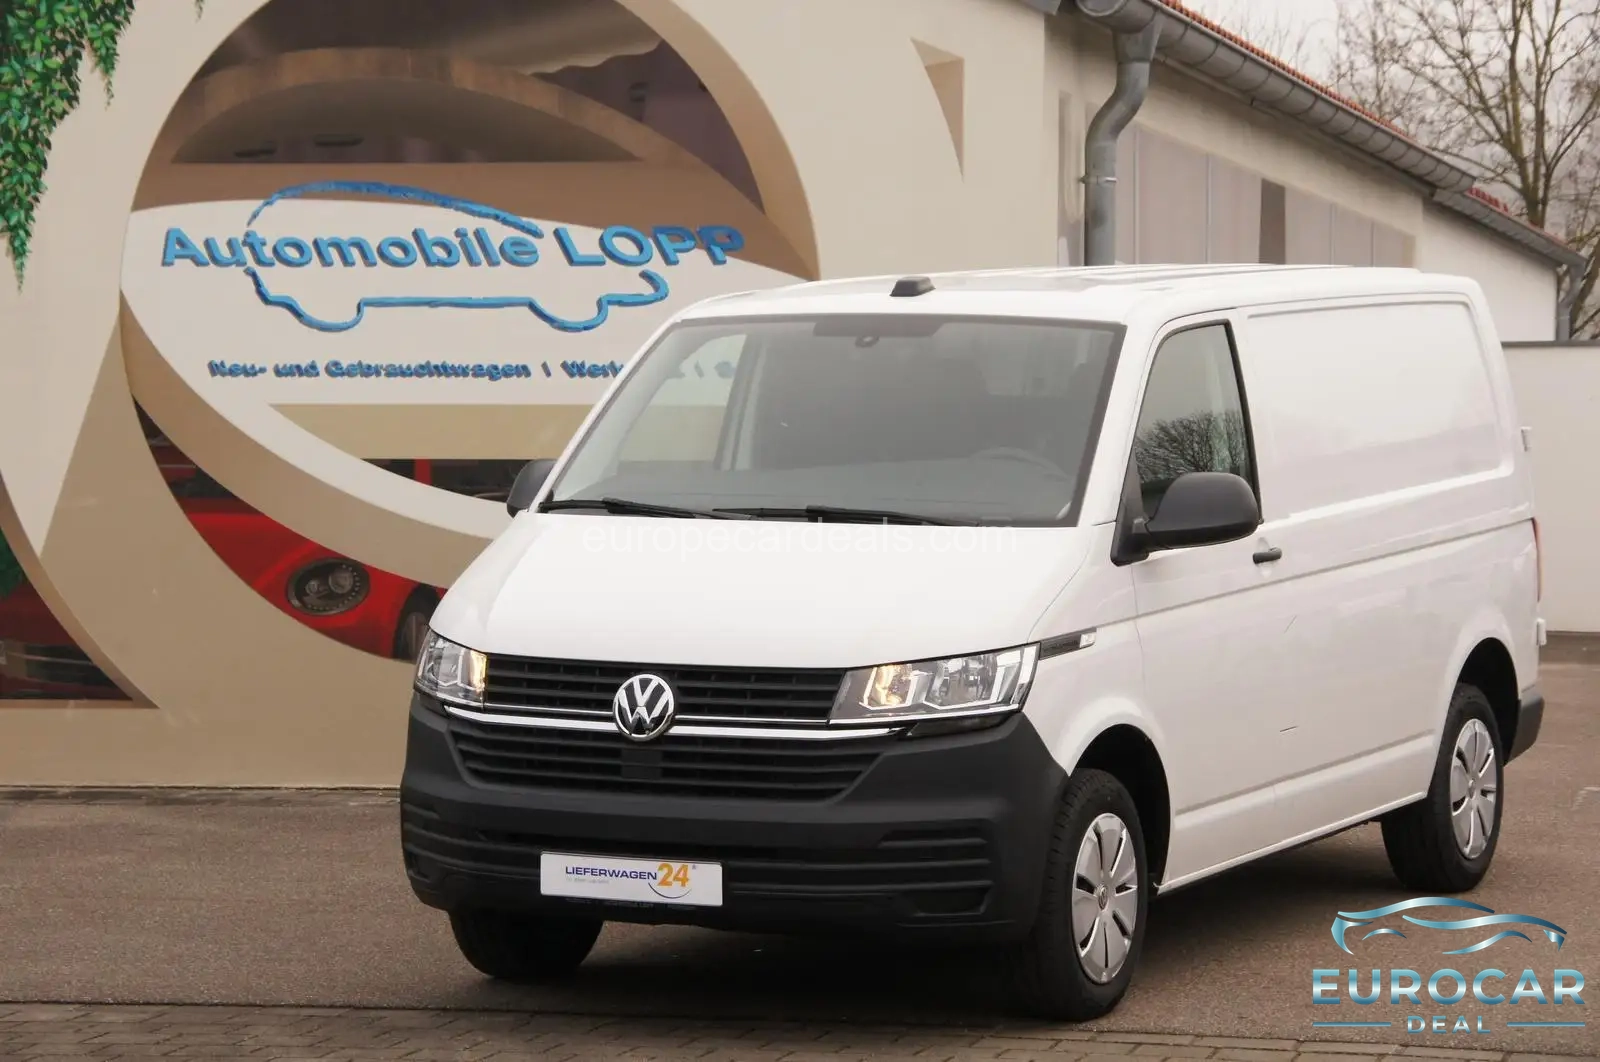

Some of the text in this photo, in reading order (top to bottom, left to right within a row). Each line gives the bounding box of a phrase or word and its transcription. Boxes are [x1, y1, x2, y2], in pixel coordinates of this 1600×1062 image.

[161, 225, 745, 267] Automobile LOPP
[207, 360, 267, 378] Neu-
[273, 360, 320, 378] und
[324, 360, 531, 381] Gebrauchtwagen
[560, 360, 624, 378] Werk
